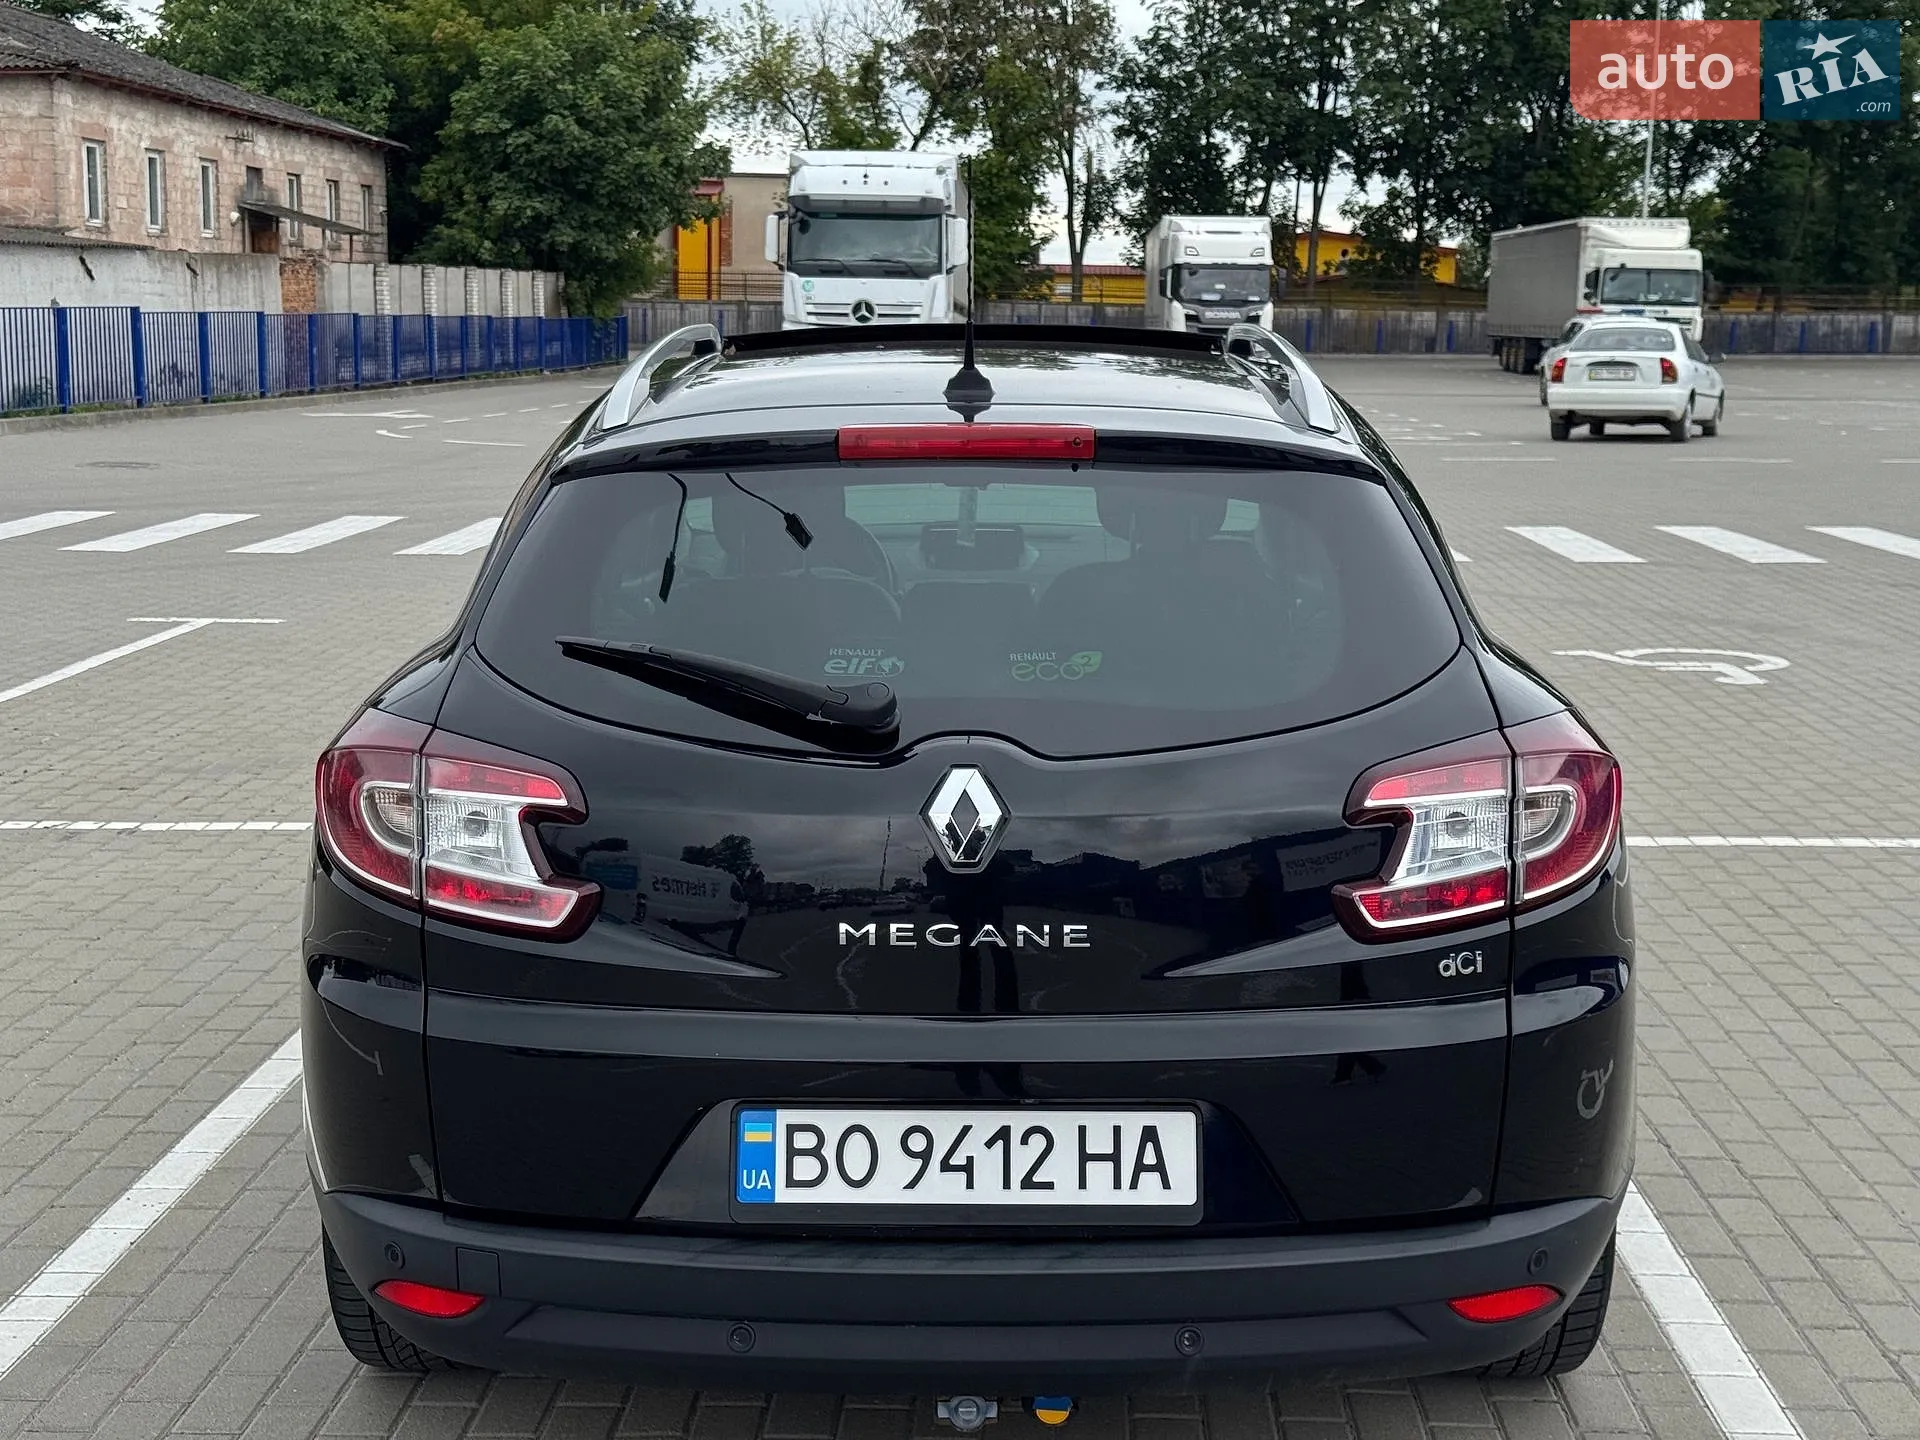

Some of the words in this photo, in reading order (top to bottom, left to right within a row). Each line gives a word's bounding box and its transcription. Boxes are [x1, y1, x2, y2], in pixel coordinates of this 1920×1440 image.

[829, 648, 884, 657] RENAULT
[1010, 651, 1057, 662] RENAULT
[838, 922, 1091, 949] MEGANE
[1438, 951, 1483, 977] dCi
[785, 1124, 878, 1189] BO
[900, 1124, 1055, 1190] 9412
[1078, 1125, 1172, 1190] HA
[743, 1169, 772, 1189] UA
